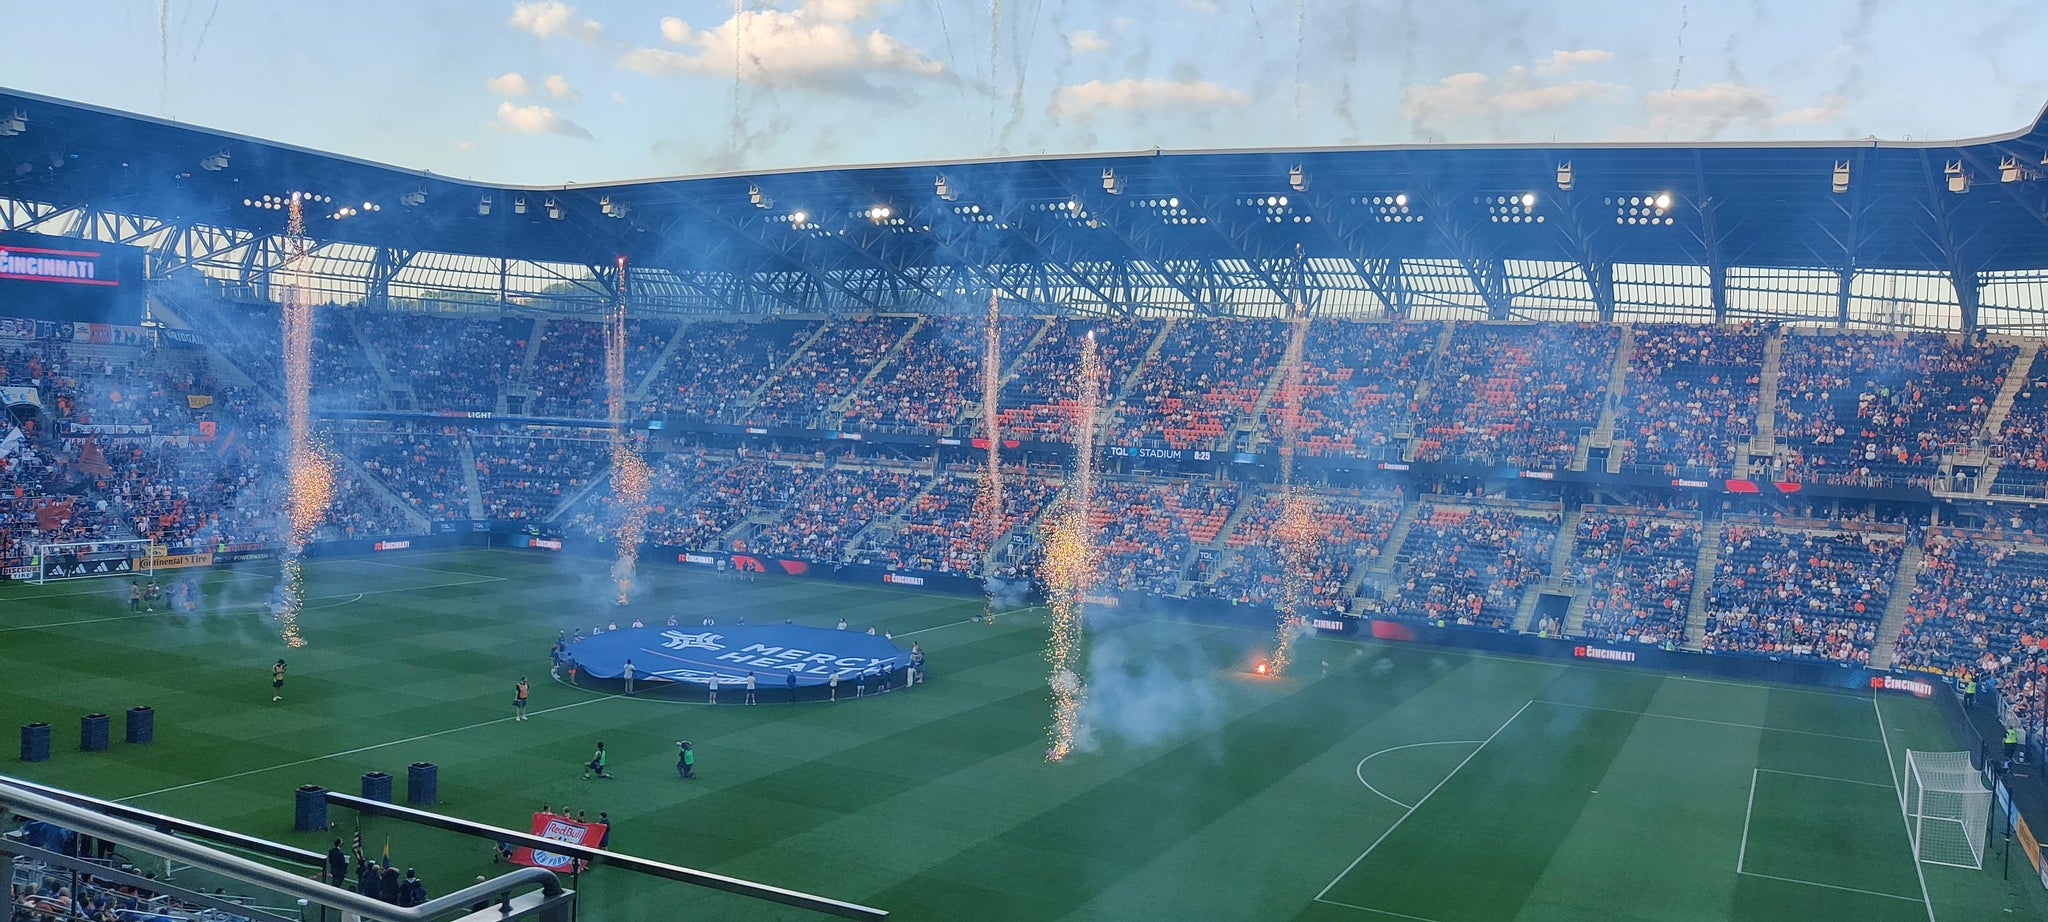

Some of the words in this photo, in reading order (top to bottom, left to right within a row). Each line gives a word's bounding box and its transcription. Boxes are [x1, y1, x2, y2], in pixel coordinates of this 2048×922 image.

[0, 252, 94, 279] CINCINNATI
[467, 411, 492, 419] LIGHT
[1111, 446, 1128, 456] TQL
[1139, 448, 1181, 459] STADIUM
[741, 644, 898, 667] MERCY
[1574, 646, 1586, 657] FC
[1586, 645, 1635, 662] CINCINNATI
[1884, 676, 1932, 695] CINCINNATI
